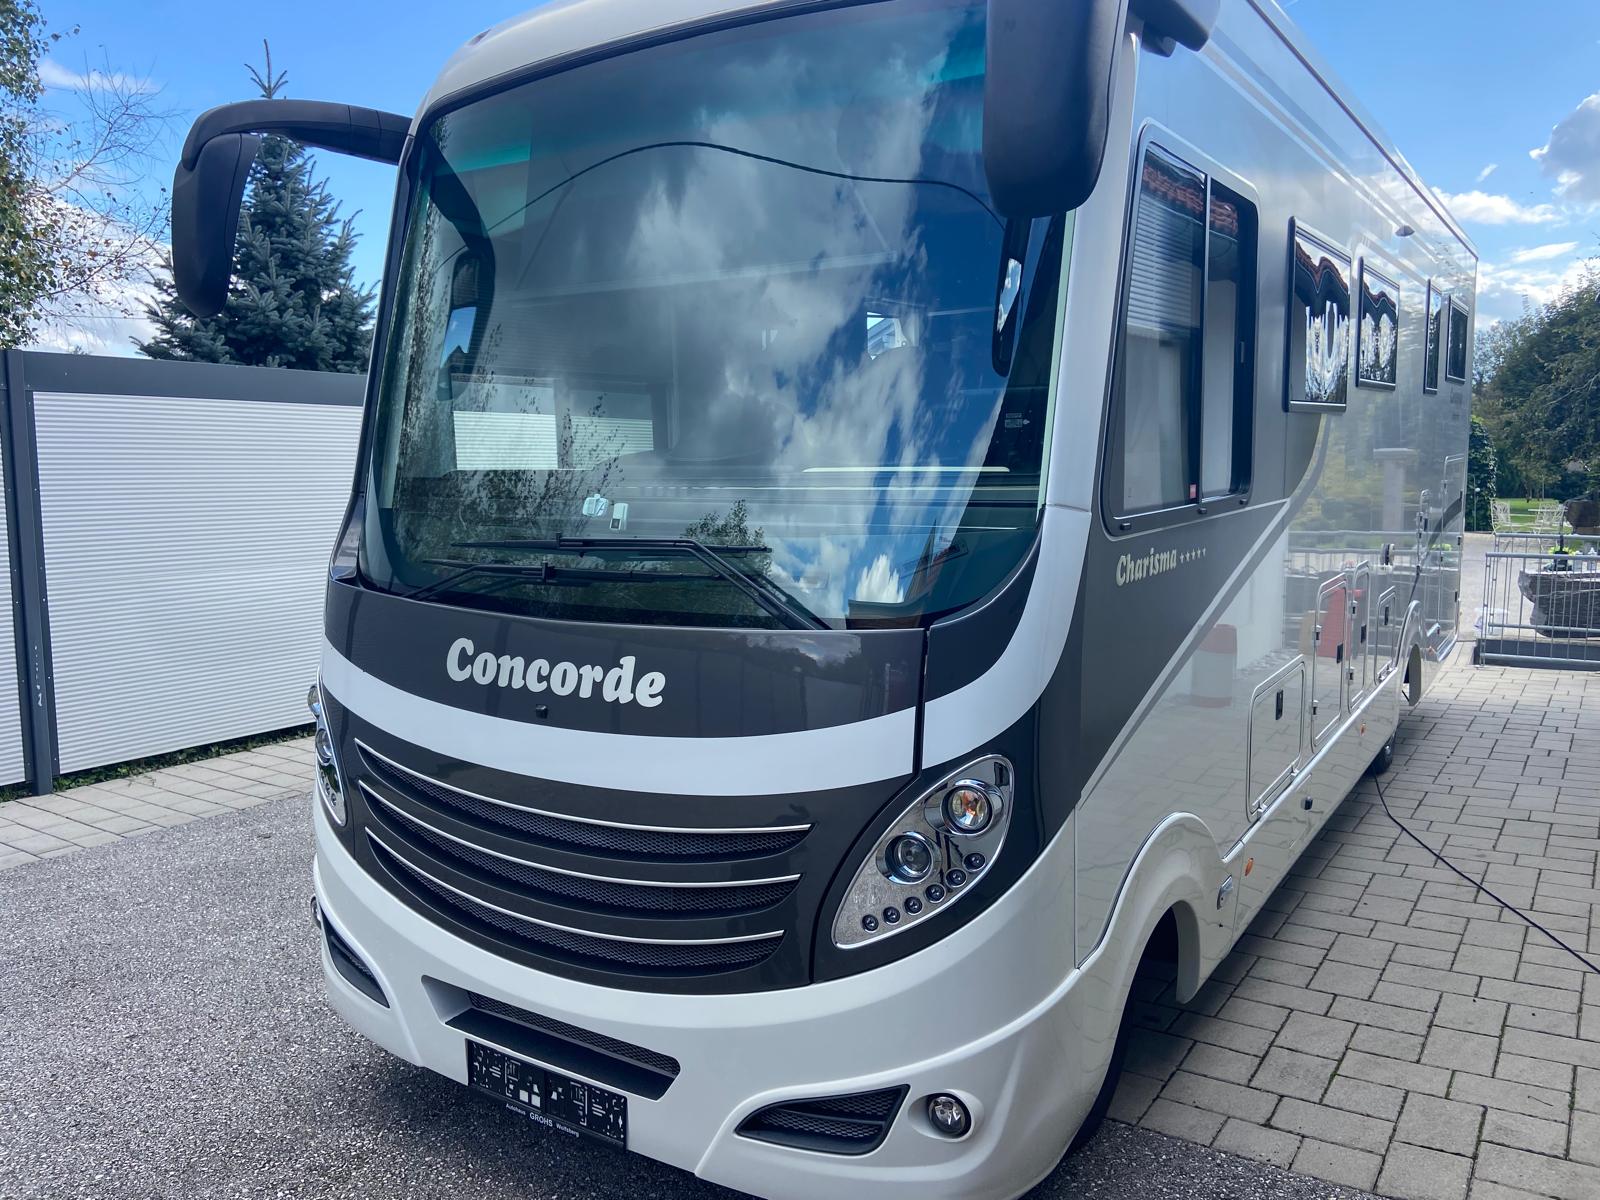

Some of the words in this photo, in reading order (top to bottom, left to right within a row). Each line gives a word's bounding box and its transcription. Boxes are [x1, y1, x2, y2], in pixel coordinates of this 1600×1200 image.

[1116, 547, 1177, 587] Charisma
[446, 637, 666, 708] Concorde
[529, 1112, 553, 1127] GROHS
